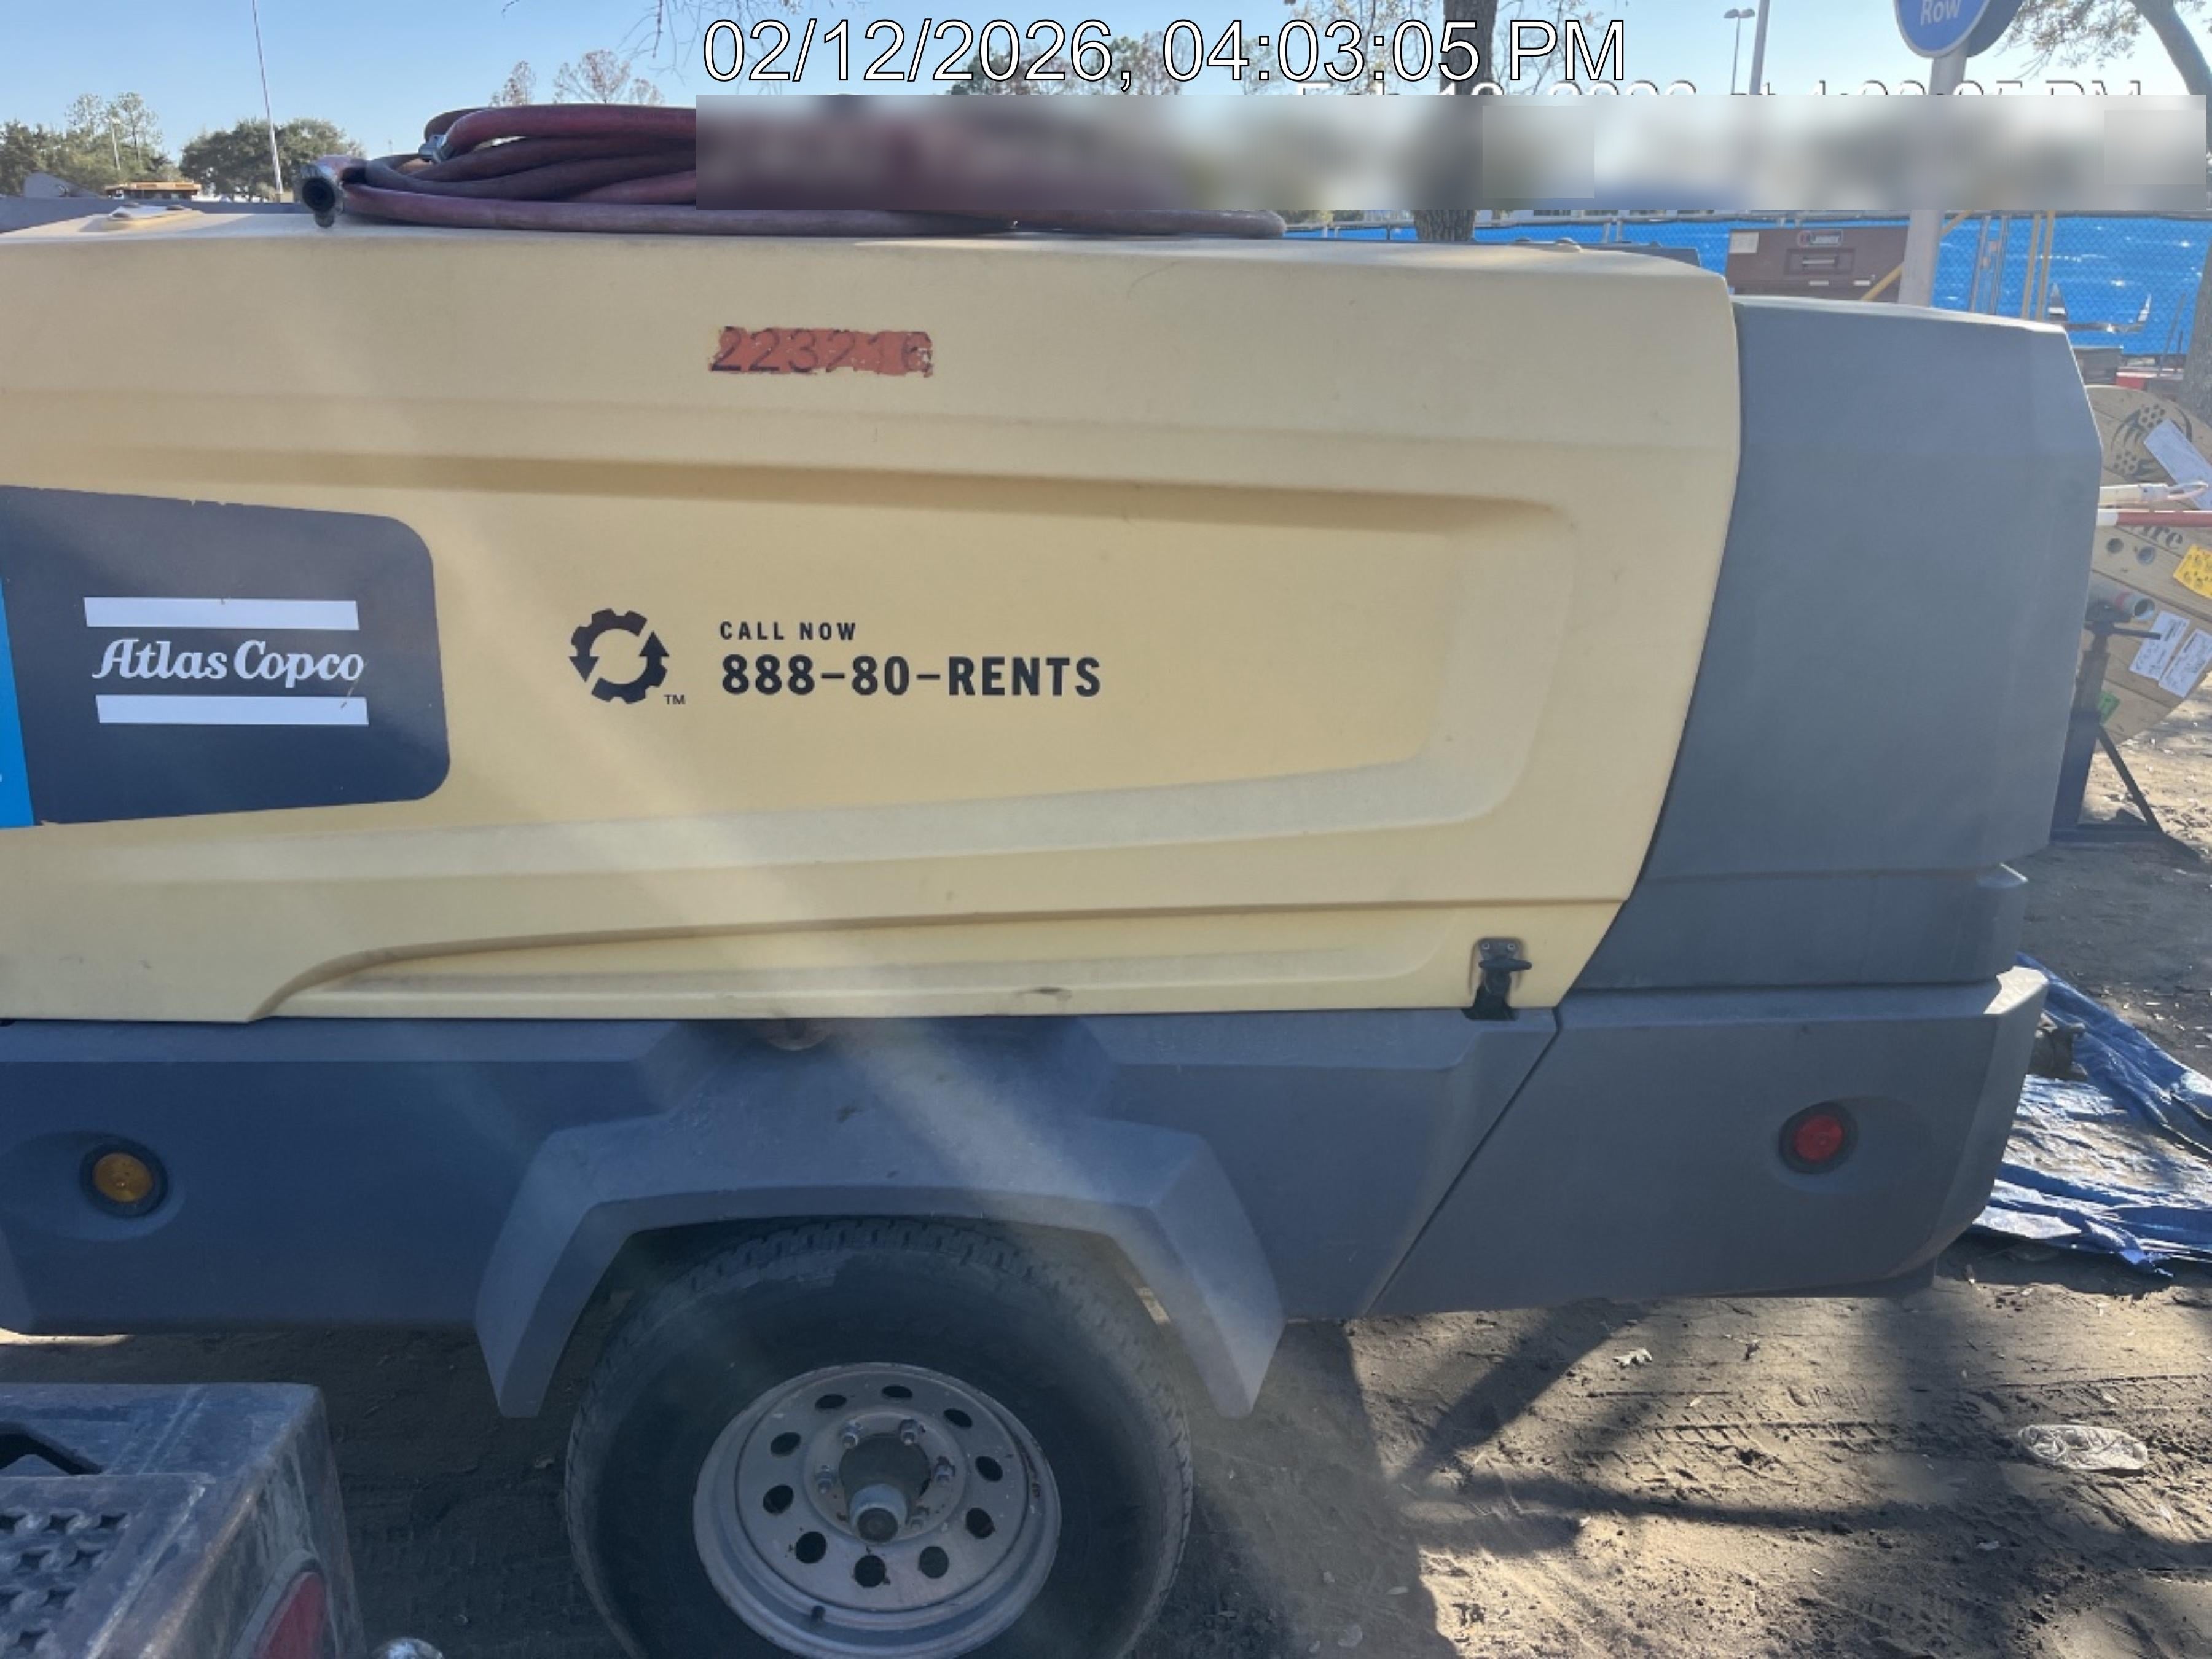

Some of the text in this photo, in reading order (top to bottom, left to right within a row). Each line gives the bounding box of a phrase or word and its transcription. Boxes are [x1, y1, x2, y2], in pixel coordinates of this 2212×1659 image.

[720, 622, 856, 641] CALL NOW
[92, 639, 364, 688] Atlas Copco
[722, 654, 1100, 697] 888-80-RENTS
[664, 694, 686, 705] TM
